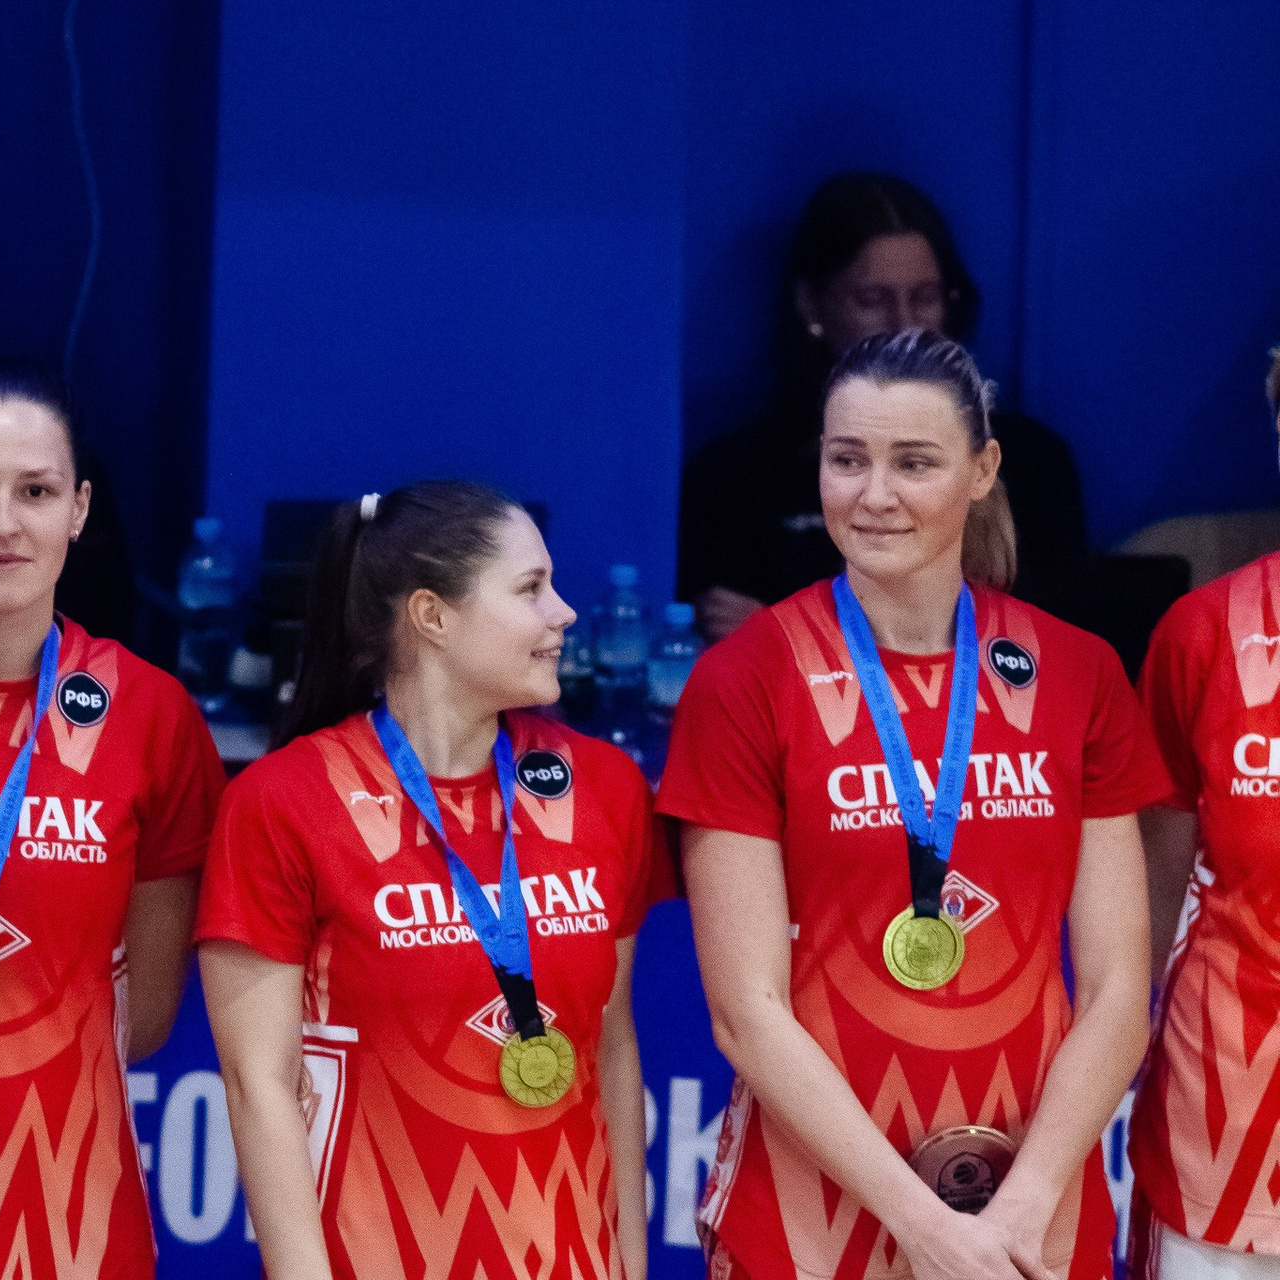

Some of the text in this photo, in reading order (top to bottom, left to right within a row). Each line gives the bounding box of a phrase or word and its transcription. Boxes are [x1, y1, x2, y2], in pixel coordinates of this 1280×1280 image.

[994, 651, 1030, 671] РФБ
[65, 689, 102, 709] РФБ
[523, 765, 564, 783] РФБ
[981, 798, 1055, 819] ОБЛАСТЬ
[20, 840, 107, 864] ОБЛАСТЬ
[536, 912, 609, 937] ОБЛАСТЬ
